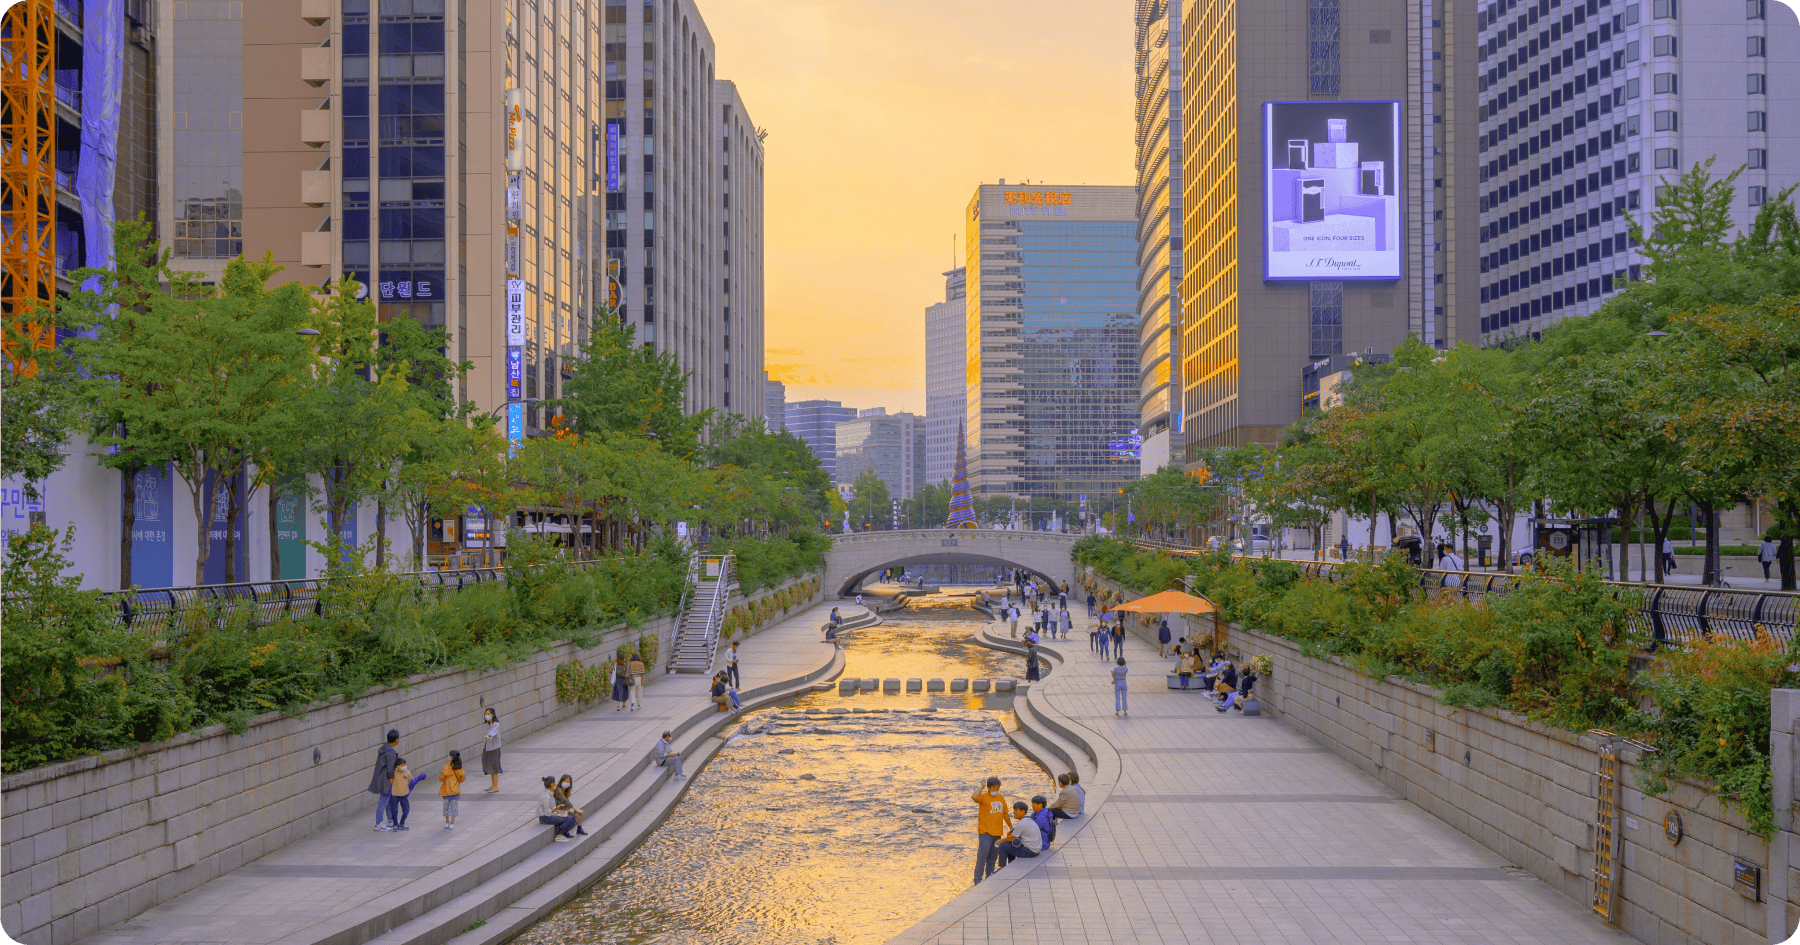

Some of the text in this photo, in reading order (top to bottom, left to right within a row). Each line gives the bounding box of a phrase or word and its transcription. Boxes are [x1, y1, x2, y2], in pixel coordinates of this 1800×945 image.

[1010, 207, 1067, 216] DUTY FREE
[1324, 256, 1362, 270] Dupont
[380, 281, 432, 298] 단월드
[609, 282, 617, 307] BAR
[511, 293, 522, 334] 피부관리
[132, 530, 144, 541] 사에
